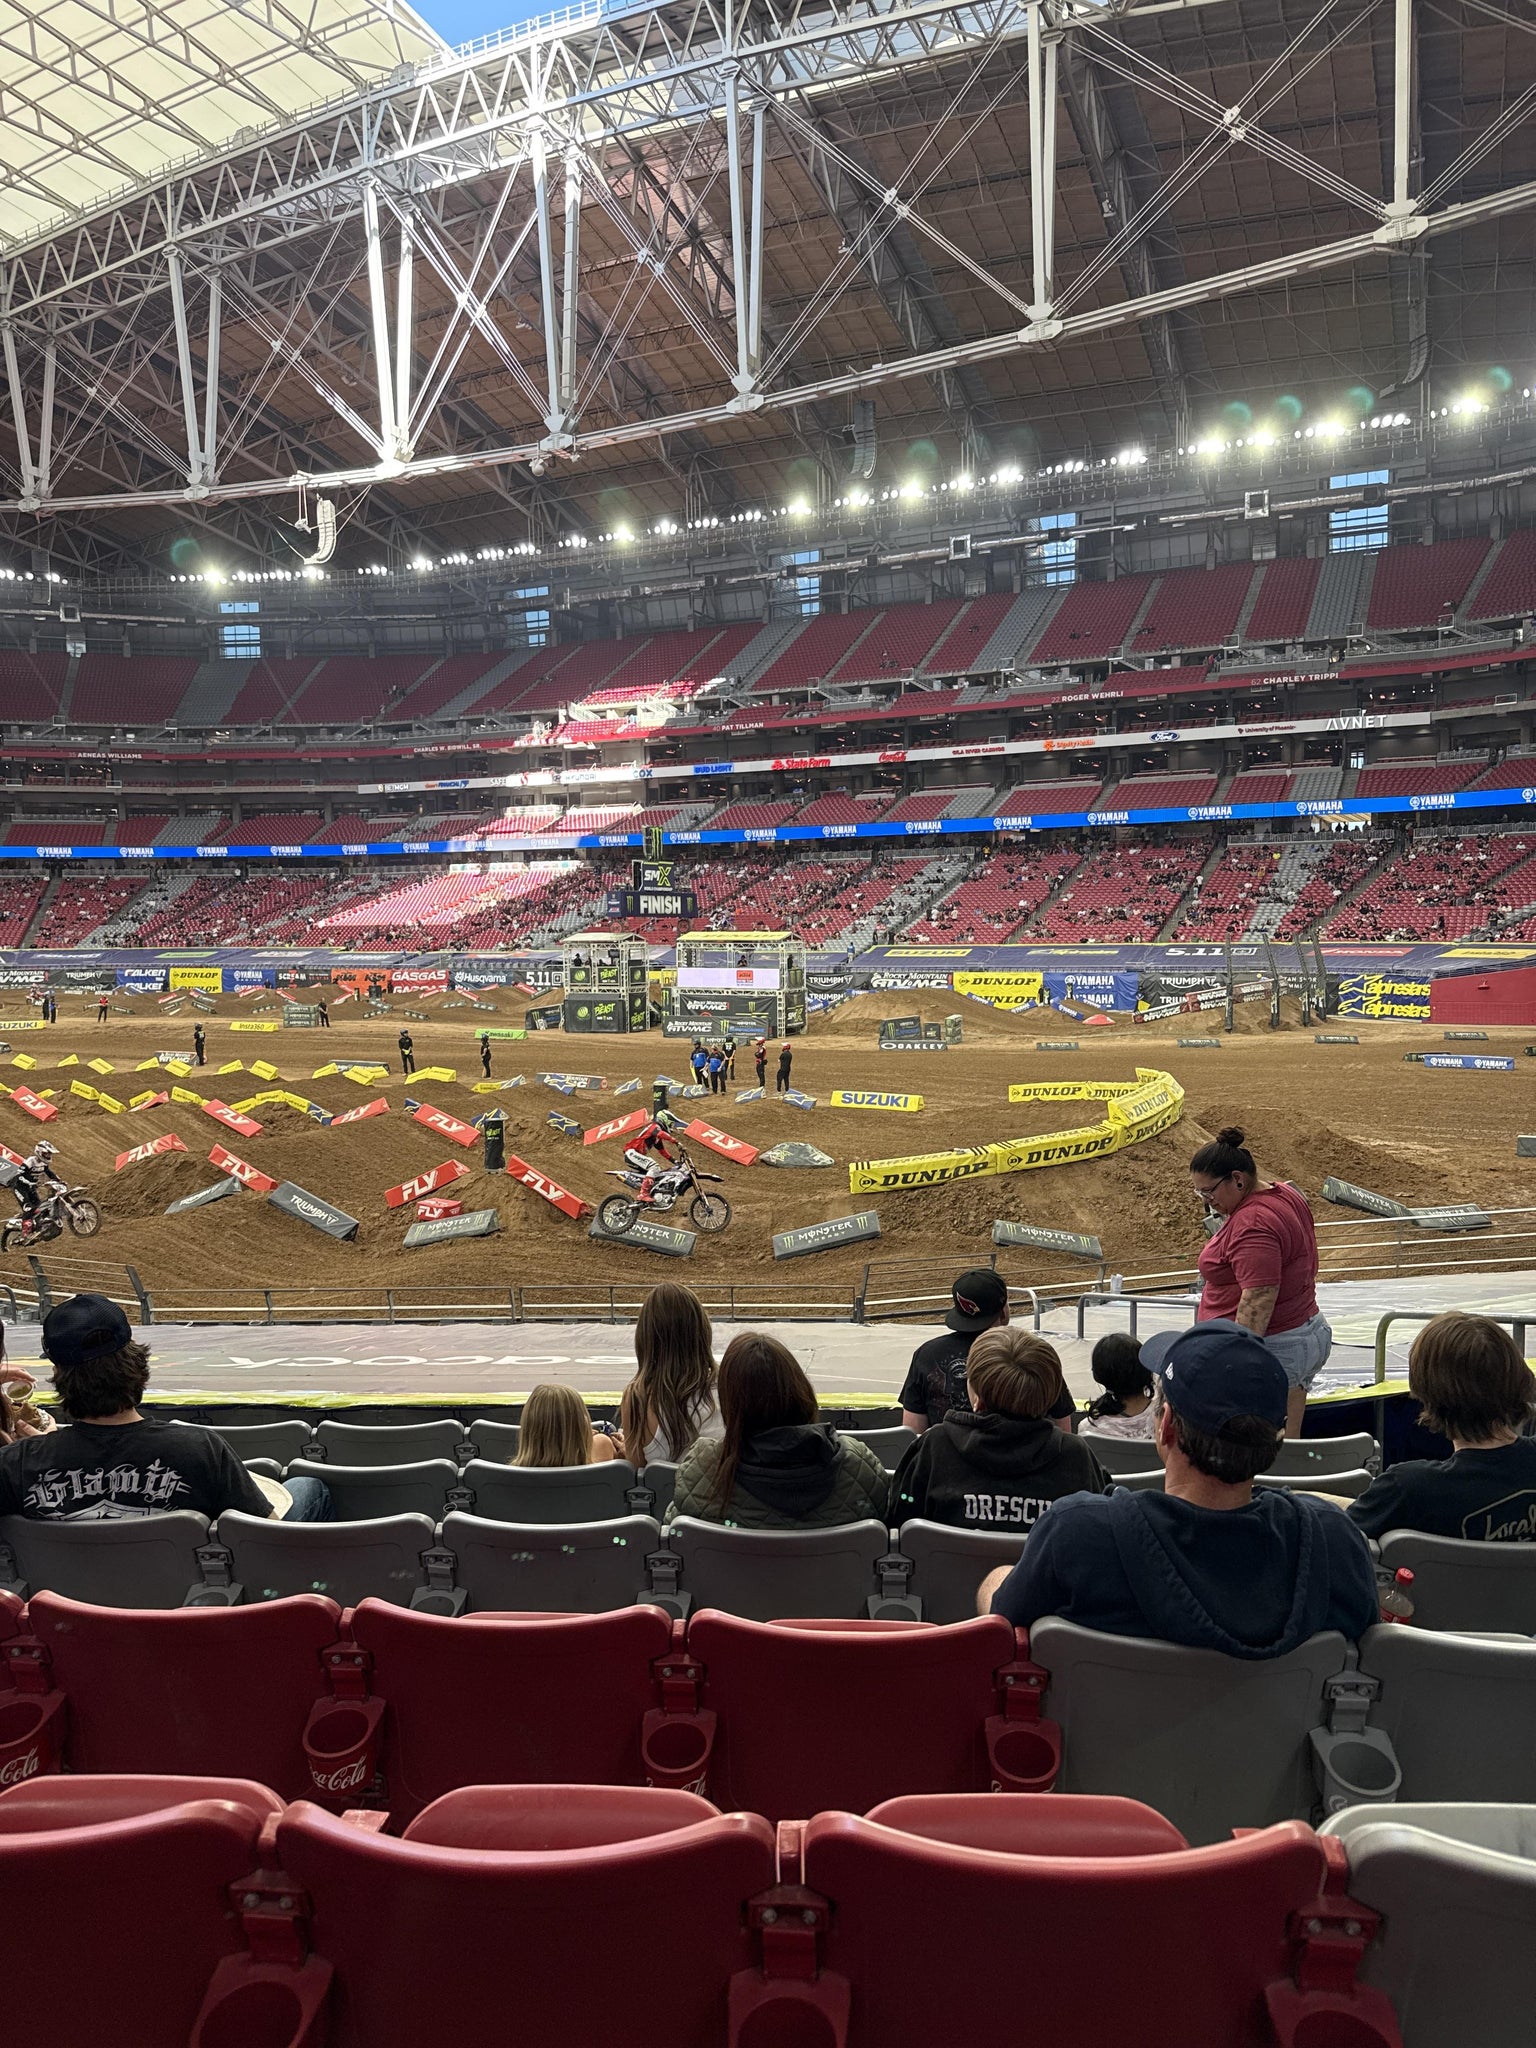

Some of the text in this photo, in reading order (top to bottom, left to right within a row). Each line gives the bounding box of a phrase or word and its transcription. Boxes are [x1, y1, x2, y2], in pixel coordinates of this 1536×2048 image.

[1263, 674, 1306, 685] CHARLEY
[1308, 672, 1339, 682] TRIPPI
[1061, 693, 1091, 702] ROGER
[1091, 690, 1124, 700] WEHRLI
[735, 722, 764, 730] TILLMAN
[1325, 714, 1388, 731] AVNET
[1154, 732, 1176, 742] Ford
[694, 763, 733, 774] BUD LIGHT
[785, 757, 831, 769] State Farm
[633, 769, 653, 779] COX
[1307, 801, 1343, 811] YAMAHA
[1420, 795, 1455, 805] YAMAHA
[1097, 812, 1129, 822] YAMAHA
[1198, 806, 1232, 816] YAMAHA
[914, 821, 942, 830] YAMAHA
[1002, 816, 1032, 826] YAMAHA
[752, 829, 777, 837] YAMAHA
[831, 825, 857, 834] YAMAHA
[606, 835, 629, 843] YAMAHA
[44, 847, 72, 855] YAMAHA
[127, 847, 154, 855] YAMAHA
[203, 847, 228, 855] YAMAHA
[278, 846, 302, 854] YAMAHA
[347, 844, 367, 852] YAMAHA
[644, 866, 672, 886] SMX
[640, 895, 681, 914] FINISH
[1165, 947, 1224, 956] 5.11
[66, 971, 95, 979] TRIUMPH
[124, 969, 167, 977] FALKEN
[240, 970, 263, 979] YAMAHA
[391, 970, 446, 981] GASGAS
[463, 972, 507, 983] Husqvarna
[526, 971, 550, 986] 5.11
[910, 972, 948, 980] MOUNTAIN
[808, 976, 844, 984] TRIUMPH
[970, 977, 1037, 986] DUNLOP
[1075, 975, 1115, 986] YAMAHA
[1160, 977, 1205, 985] TRIUMPH
[1366, 981, 1431, 997] alpinestars
[594, 1003, 616, 1017] BEAST
[1366, 1002, 1431, 1018] alpinestars
[1021, 1086, 1082, 1097] DUNLOP
[19, 1094, 47, 1111] FLY
[841, 1092, 909, 1109] SUZUKI
[1133, 1090, 1170, 1117] DUNLOP
[215, 1107, 250, 1125] FLY
[340, 1104, 372, 1124] FLY
[427, 1113, 465, 1133] FLY
[596, 1117, 631, 1140] FLY
[701, 1129, 743, 1150] FLY
[1025, 1136, 1114, 1165] DUNLOP
[221, 1155, 260, 1183] FLY
[880, 1162, 989, 1187] DUNLOP
[401, 1169, 438, 1201] FLY
[521, 1170, 566, 1201] FLY
[1350, 1188, 1391, 1207] MONSTER
[290, 1194, 328, 1221] TRIUMPH
[417, 1205, 444, 1219] FLY
[427, 1216, 471, 1231] MONSTER
[618, 1220, 670, 1239] MNSTER
[798, 1221, 853, 1241] MONSTER
[1020, 1225, 1076, 1243] MONSTER
[207, 1355, 638, 1369] eacock
[312, 1752, 367, 1791] ca-Cola
